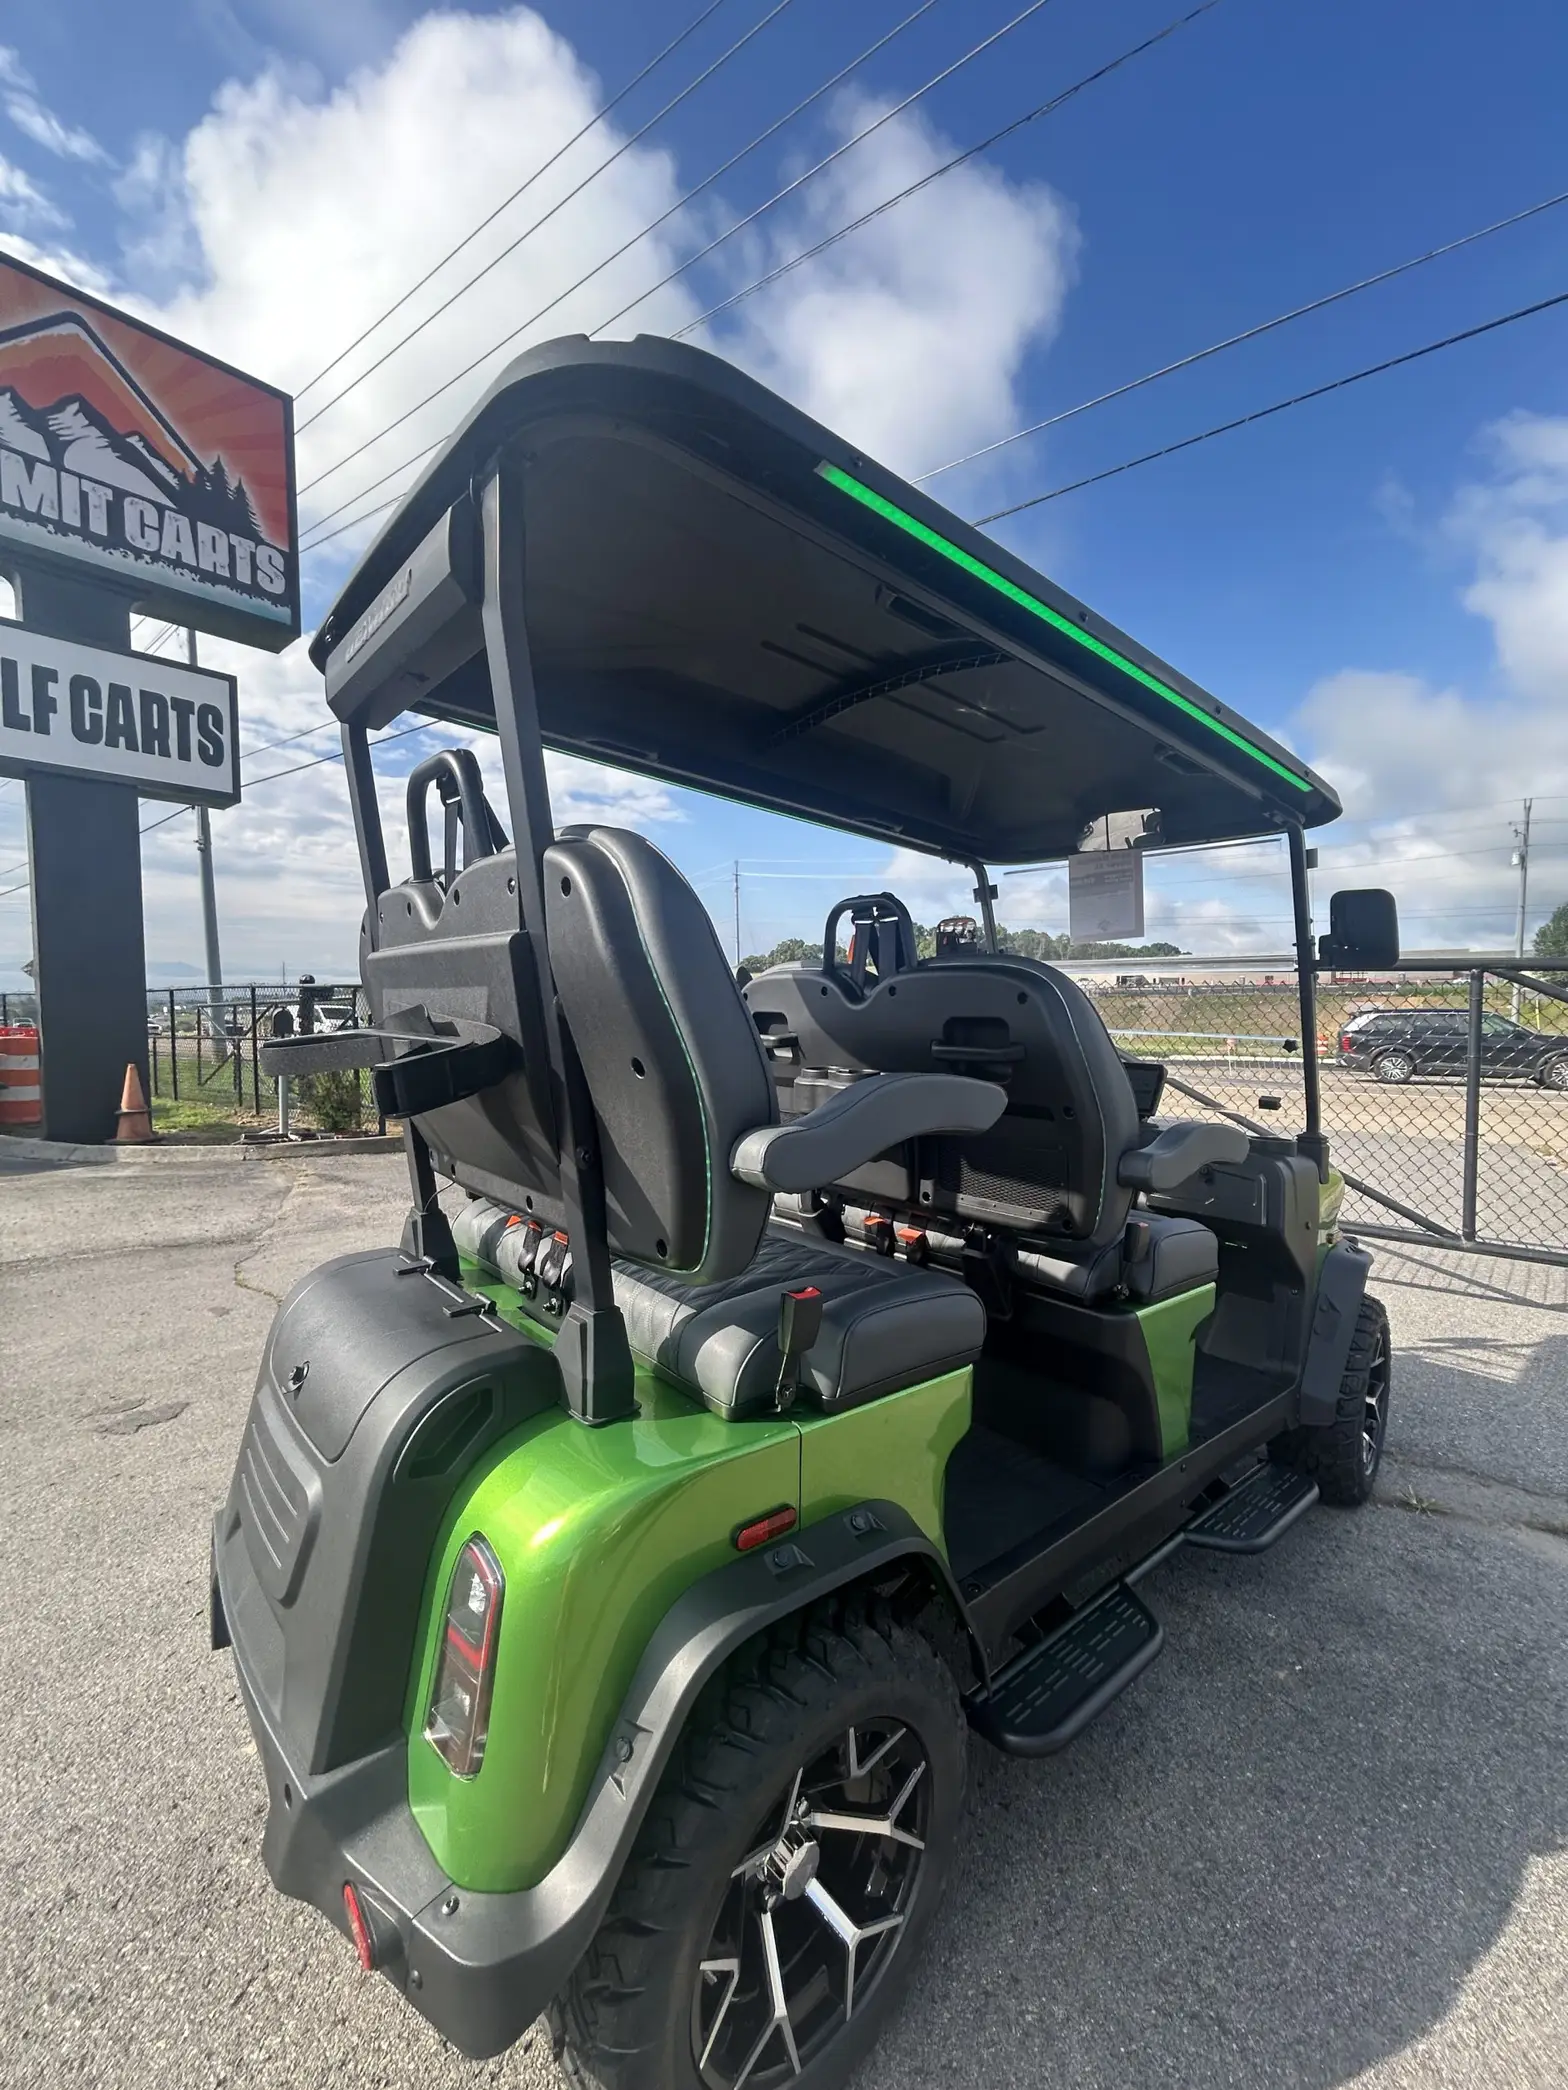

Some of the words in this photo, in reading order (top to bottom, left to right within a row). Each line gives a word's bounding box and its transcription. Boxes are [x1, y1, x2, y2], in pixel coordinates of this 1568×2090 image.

[1, 448, 114, 536] MIT
[123, 496, 286, 595] CARTS
[1, 656, 59, 736] LF
[69, 674, 225, 768] CARTS
